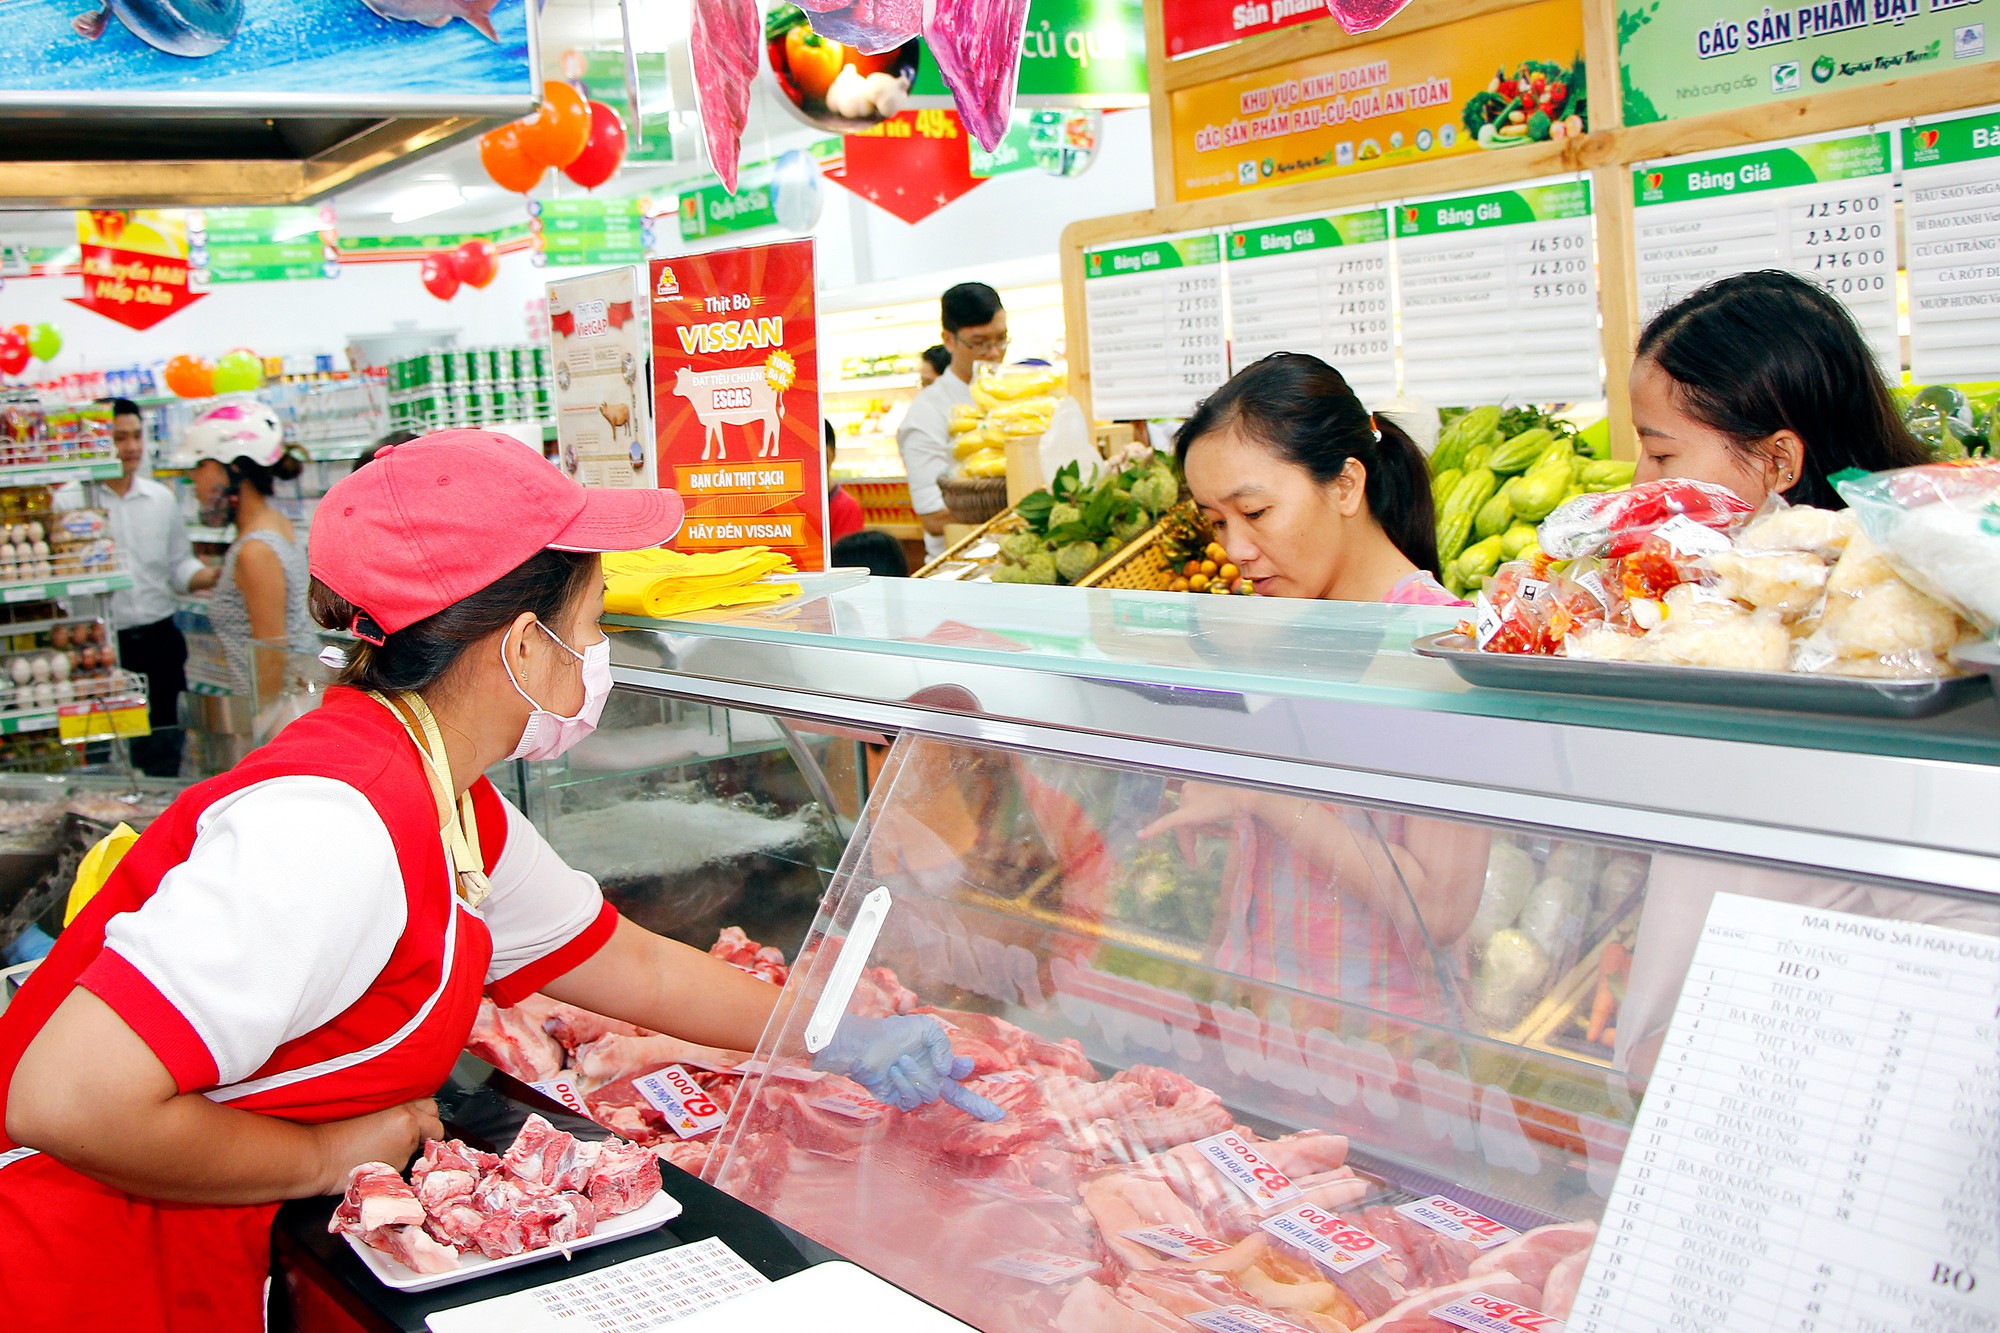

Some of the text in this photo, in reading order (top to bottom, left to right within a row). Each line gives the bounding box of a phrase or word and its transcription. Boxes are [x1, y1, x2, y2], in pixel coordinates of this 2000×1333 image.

[1233, 2, 1269, 30] Sản
[1698, 19, 1739, 56] CÁC
[1747, 9, 1791, 46] SẢN
[1242, 60, 1388, 114] KHU VỰC KINH DOANH
[1676, 86, 1700, 100] Nhà
[1702, 81, 1731, 97] cung
[1196, 128, 1221, 151] CÁC
[1223, 117, 1248, 144] SẢN
[1251, 107, 1290, 138] PHẨM
[1384, 91, 1404, 111] AN
[1407, 78, 1450, 106] TOÀN
[916, 109, 957, 139] 49%
[1688, 162, 1771, 191] Bảng Giá
[1941, 186, 1963, 199] SAO
[1437, 202, 1502, 227] Bảng Giá
[1807, 197, 1879, 219] 12500
[1952, 213, 1981, 226] XANH
[1260, 228, 1315, 250] Bảng Giá
[1807, 224, 1881, 246] 23200
[1530, 236, 1584, 252] 16500
[1114, 250, 1160, 270] Bảng Giá
[1531, 260, 1586, 276] 16200
[1814, 250, 1885, 271] 17600
[1533, 283, 1587, 299] 53500
[704, 296, 731, 315] Thịt
[733, 293, 751, 310] Bò
[575, 319, 608, 337] VietGAP
[677, 317, 783, 354] VISSAN
[771, 356, 792, 374] 100%
[692, 369, 763, 389] ĐẠT TIÊU CHUẨN
[768, 369, 778, 382] Bò
[712, 388, 751, 409] ESCAS
[690, 469, 784, 491] BẠN CẦN THỊT SẠCH
[688, 522, 792, 539] HÃY ĐẾN VISSAN
[1708, 970, 1715, 980] 1
[1777, 961, 1820, 981] HEO
[1702, 985, 1710, 997] 2
[1696, 1002, 1705, 1013] 3
[1727, 1007, 1748, 1022] BA
[1691, 1018, 1700, 1028] 4
[1685, 1035, 1695, 1046] 5
[1788, 1040, 1817, 1057] VAI
[1679, 1051, 1688, 1061] 6
[1674, 1066, 1683, 1077] 7
[643, 1077, 661, 1090] HEO
[1667, 1084, 1676, 1094] 8
[667, 1071, 718, 1118] 62.000
[1662, 1099, 1671, 1109] 9
[1654, 1117, 1669, 1128] 10
[1648, 1133, 1661, 1145] 11
[1207, 1144, 1230, 1160] HEO
[1643, 1150, 1657, 1162] 12
[1225, 1137, 1290, 1192] 82.000
[1675, 1159, 1697, 1174] BA
[1236, 1171, 1255, 1183] BA
[1637, 1167, 1651, 1179] 13
[1632, 1184, 1646, 1196] 14
[1411, 1207, 1441, 1219] HEO
[1626, 1201, 1640, 1213] 15
[1432, 1201, 1506, 1235] 112.000
[1620, 1218, 1635, 1231] 16
[1271, 1217, 1336, 1252] THỊT VAI HEO
[1614, 1235, 1629, 1247] 17
[1608, 1252, 1623, 1265] 18
[1718, 1250, 1752, 1268] HEO
[1602, 1269, 1617, 1281] 19
[1670, 1274, 1702, 1292] HEO
[1932, 1262, 1976, 1294] BÒ
[1595, 1286, 1611, 1299] 20
[1442, 1305, 1474, 1317] HEO
[1589, 1303, 1603, 1316] 21
